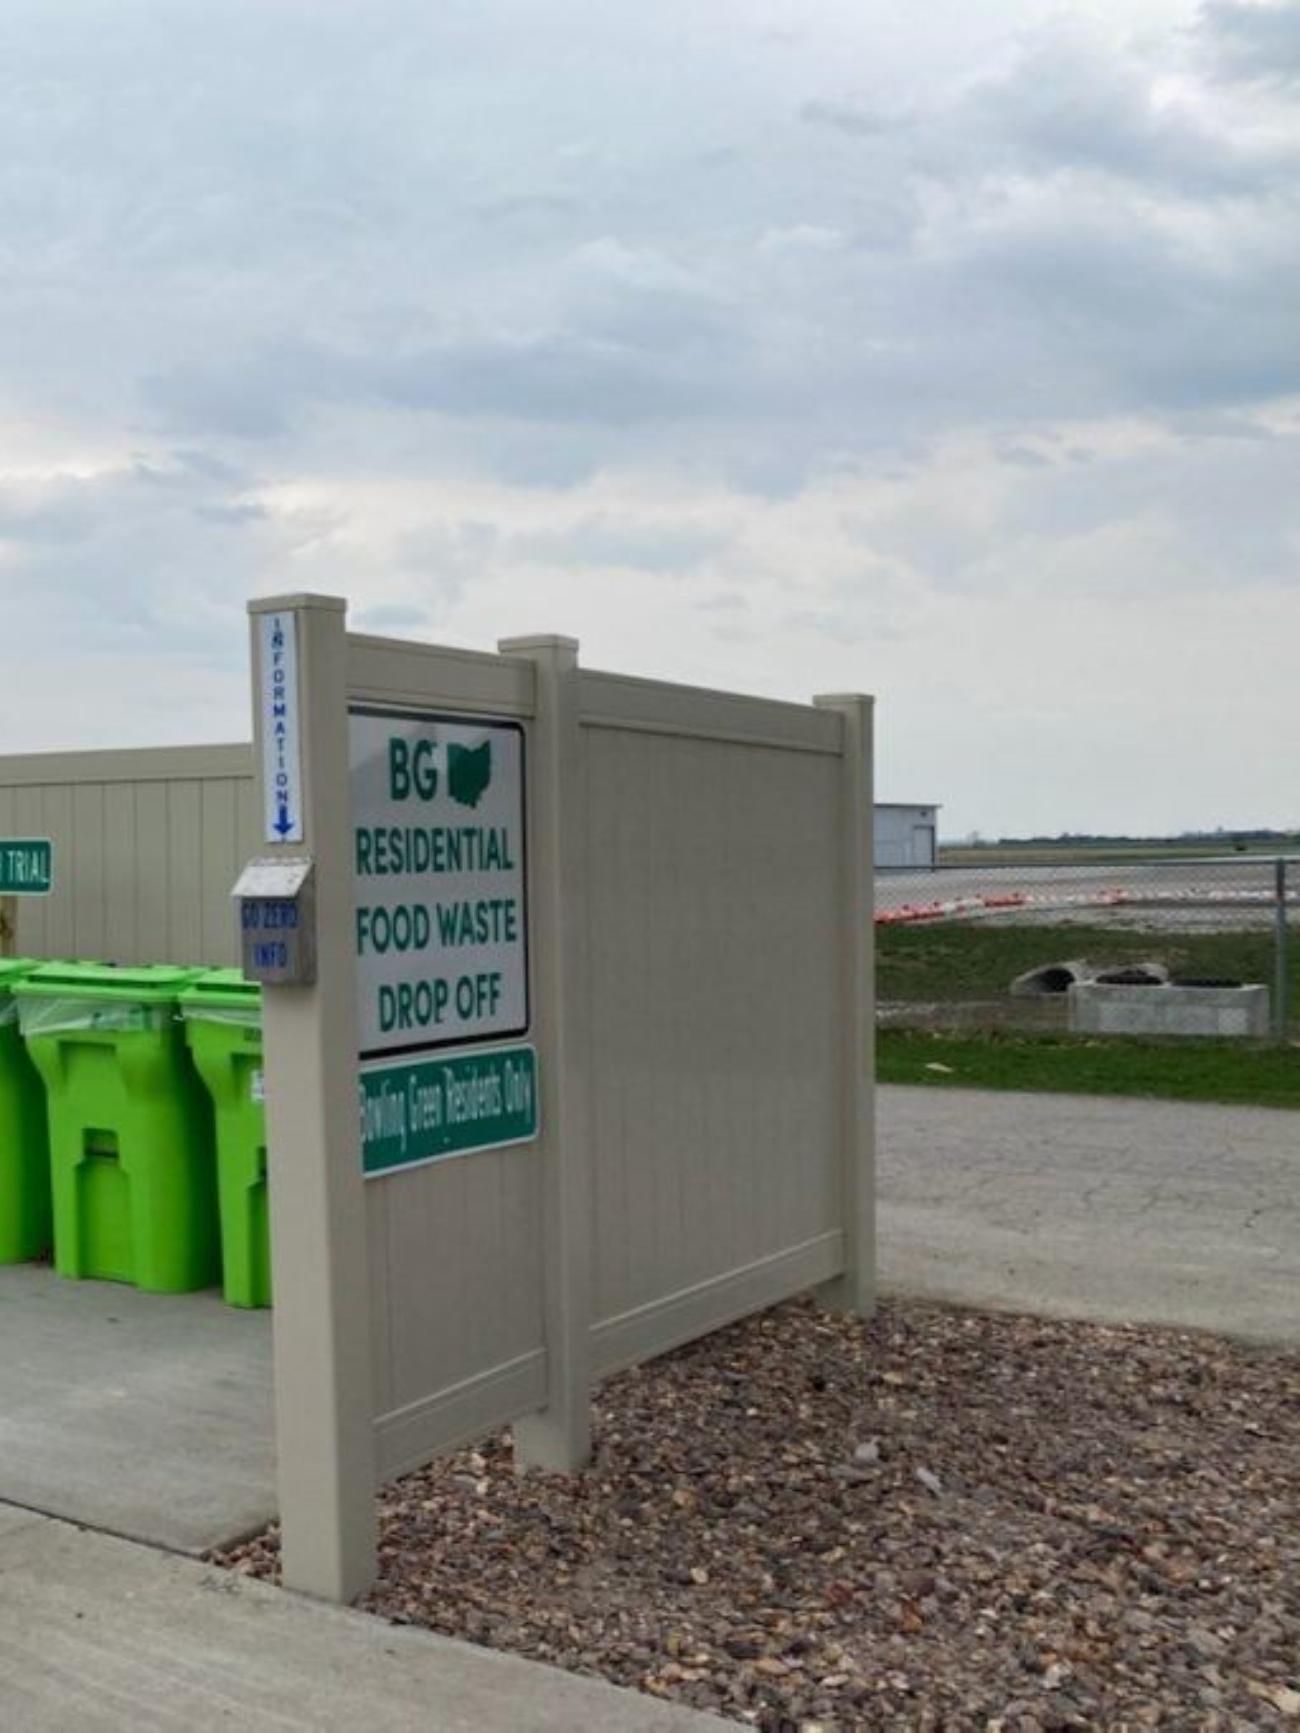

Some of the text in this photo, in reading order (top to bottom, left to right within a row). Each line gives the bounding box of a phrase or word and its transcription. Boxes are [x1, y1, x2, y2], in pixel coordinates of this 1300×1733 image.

[271, 617, 289, 803] INFORMATION
[389, 737, 438, 801] BG
[7, 850, 49, 883] TRIAL
[355, 827, 516, 876] RESIDENTIAL
[242, 902, 298, 930] GO ZERO
[356, 900, 517, 955] FOOD WASTE
[253, 941, 287, 968] INFO
[378, 972, 502, 1032] DROP OFF
[409, 1074, 442, 1133] Green
[443, 1064, 502, 1126] Residents
[504, 1059, 532, 1125] Only
